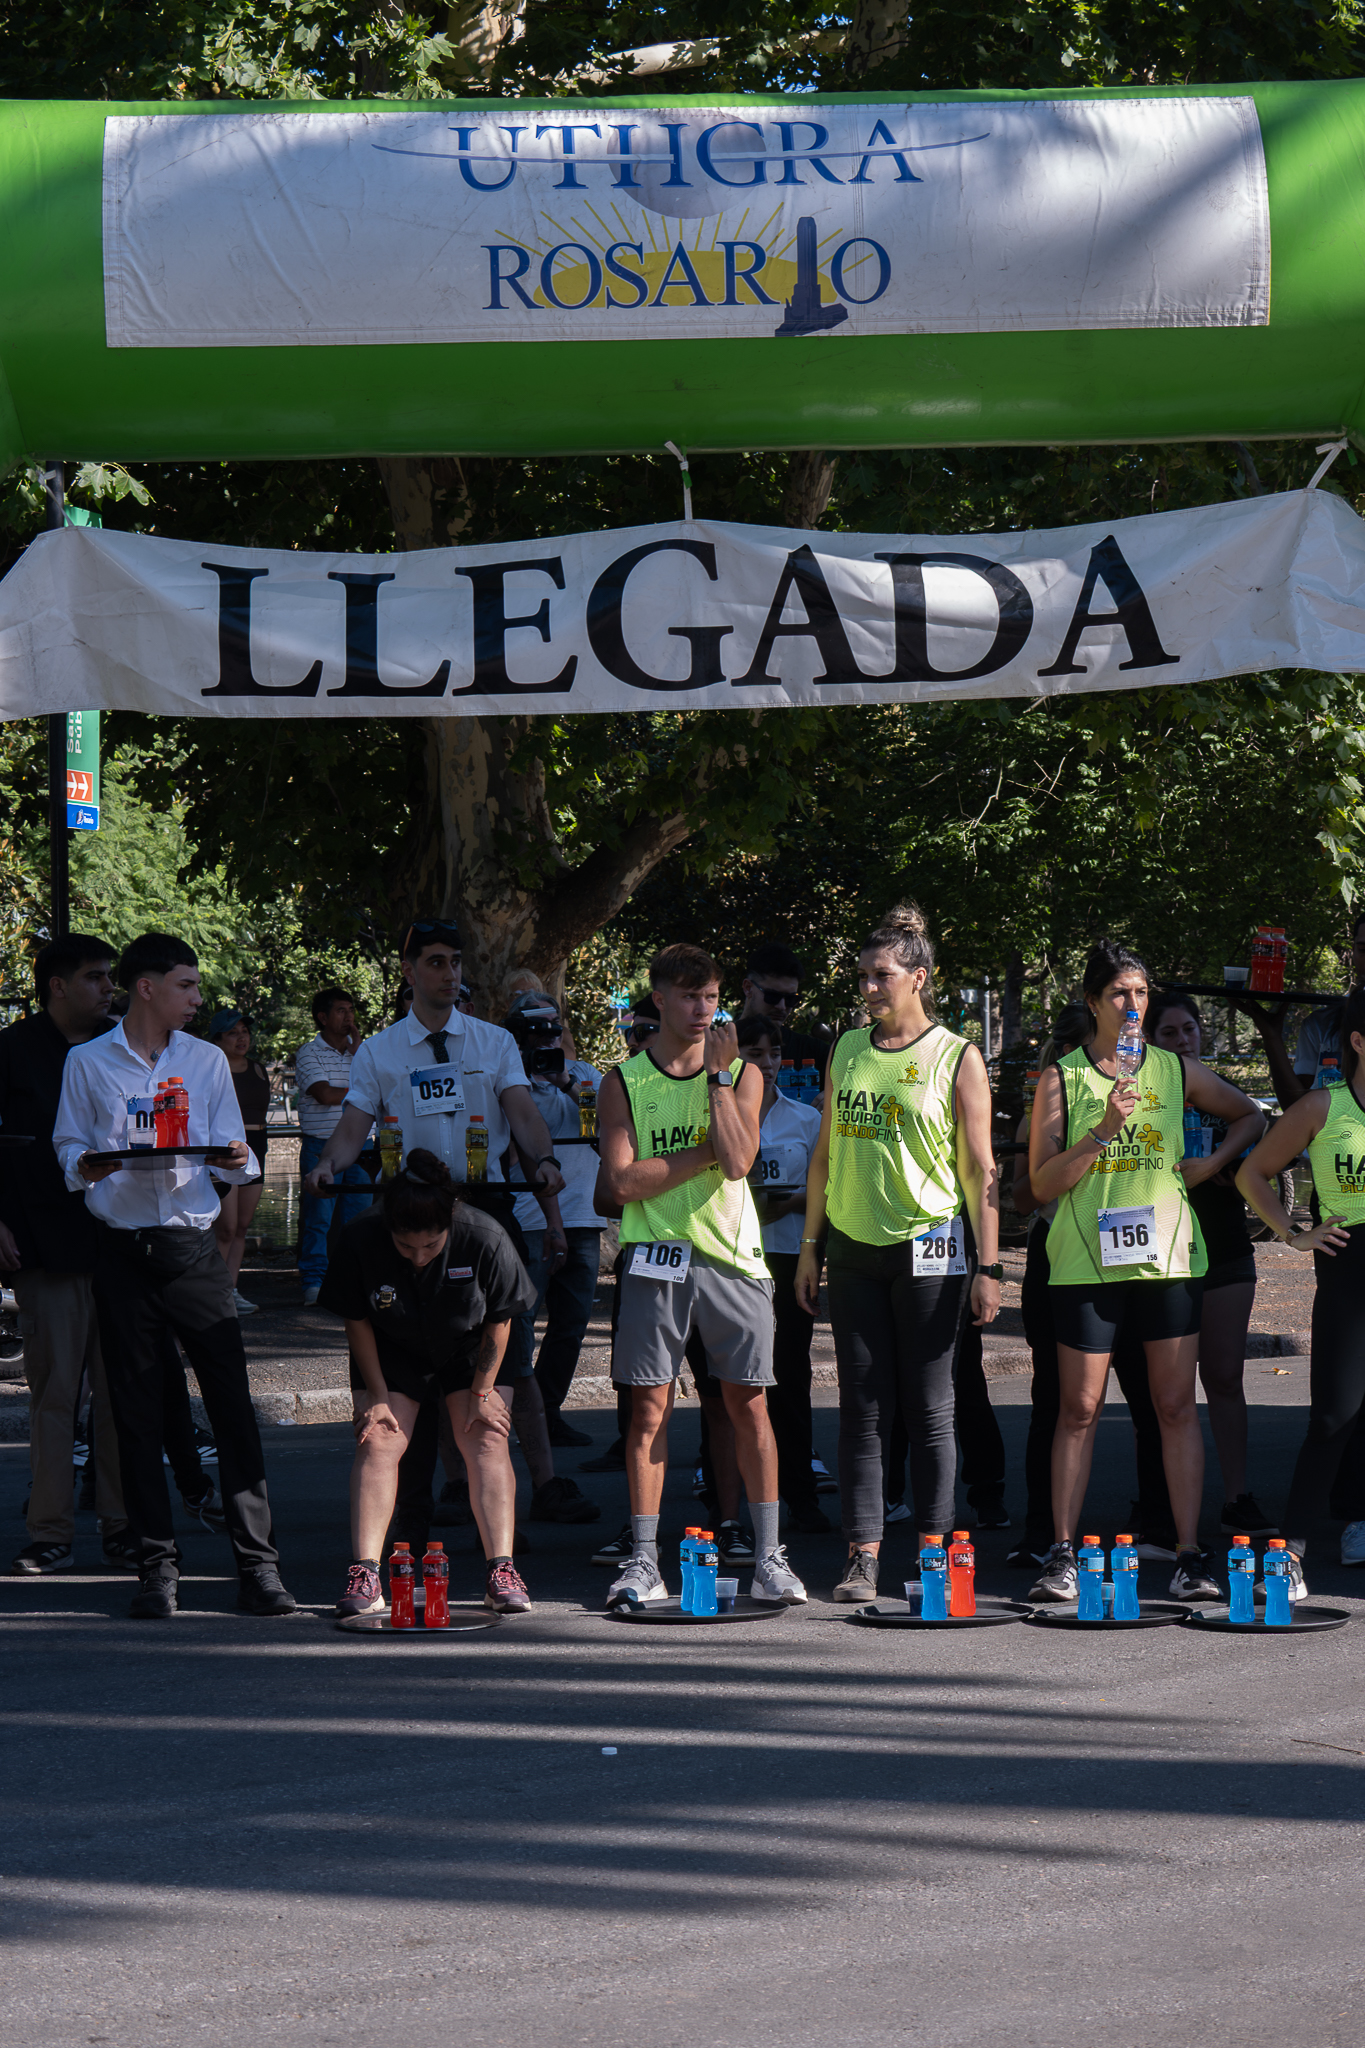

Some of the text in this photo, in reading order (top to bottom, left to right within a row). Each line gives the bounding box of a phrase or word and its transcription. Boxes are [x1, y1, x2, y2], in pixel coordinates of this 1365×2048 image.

[448, 118, 924, 193] UTHGRA
[480, 217, 892, 336] ROSARIO
[201, 534, 1181, 697] LLEGADA
[418, 1077, 457, 1101] 052
[836, 1089, 886, 1113] HAY
[454, 1102, 465, 1110] 052
[837, 1110, 883, 1126] EQUIPO
[650, 1125, 694, 1151] HAY
[836, 1123, 904, 1143] PICADOFINO
[1099, 1144, 1140, 1159] QUIPO
[1091, 1156, 1164, 1174] PICADOFINO
[922, 1236, 957, 1259] 286
[1108, 1223, 1150, 1249] 156
[645, 1242, 683, 1268] 106
[1146, 1253, 1158, 1262] 156
